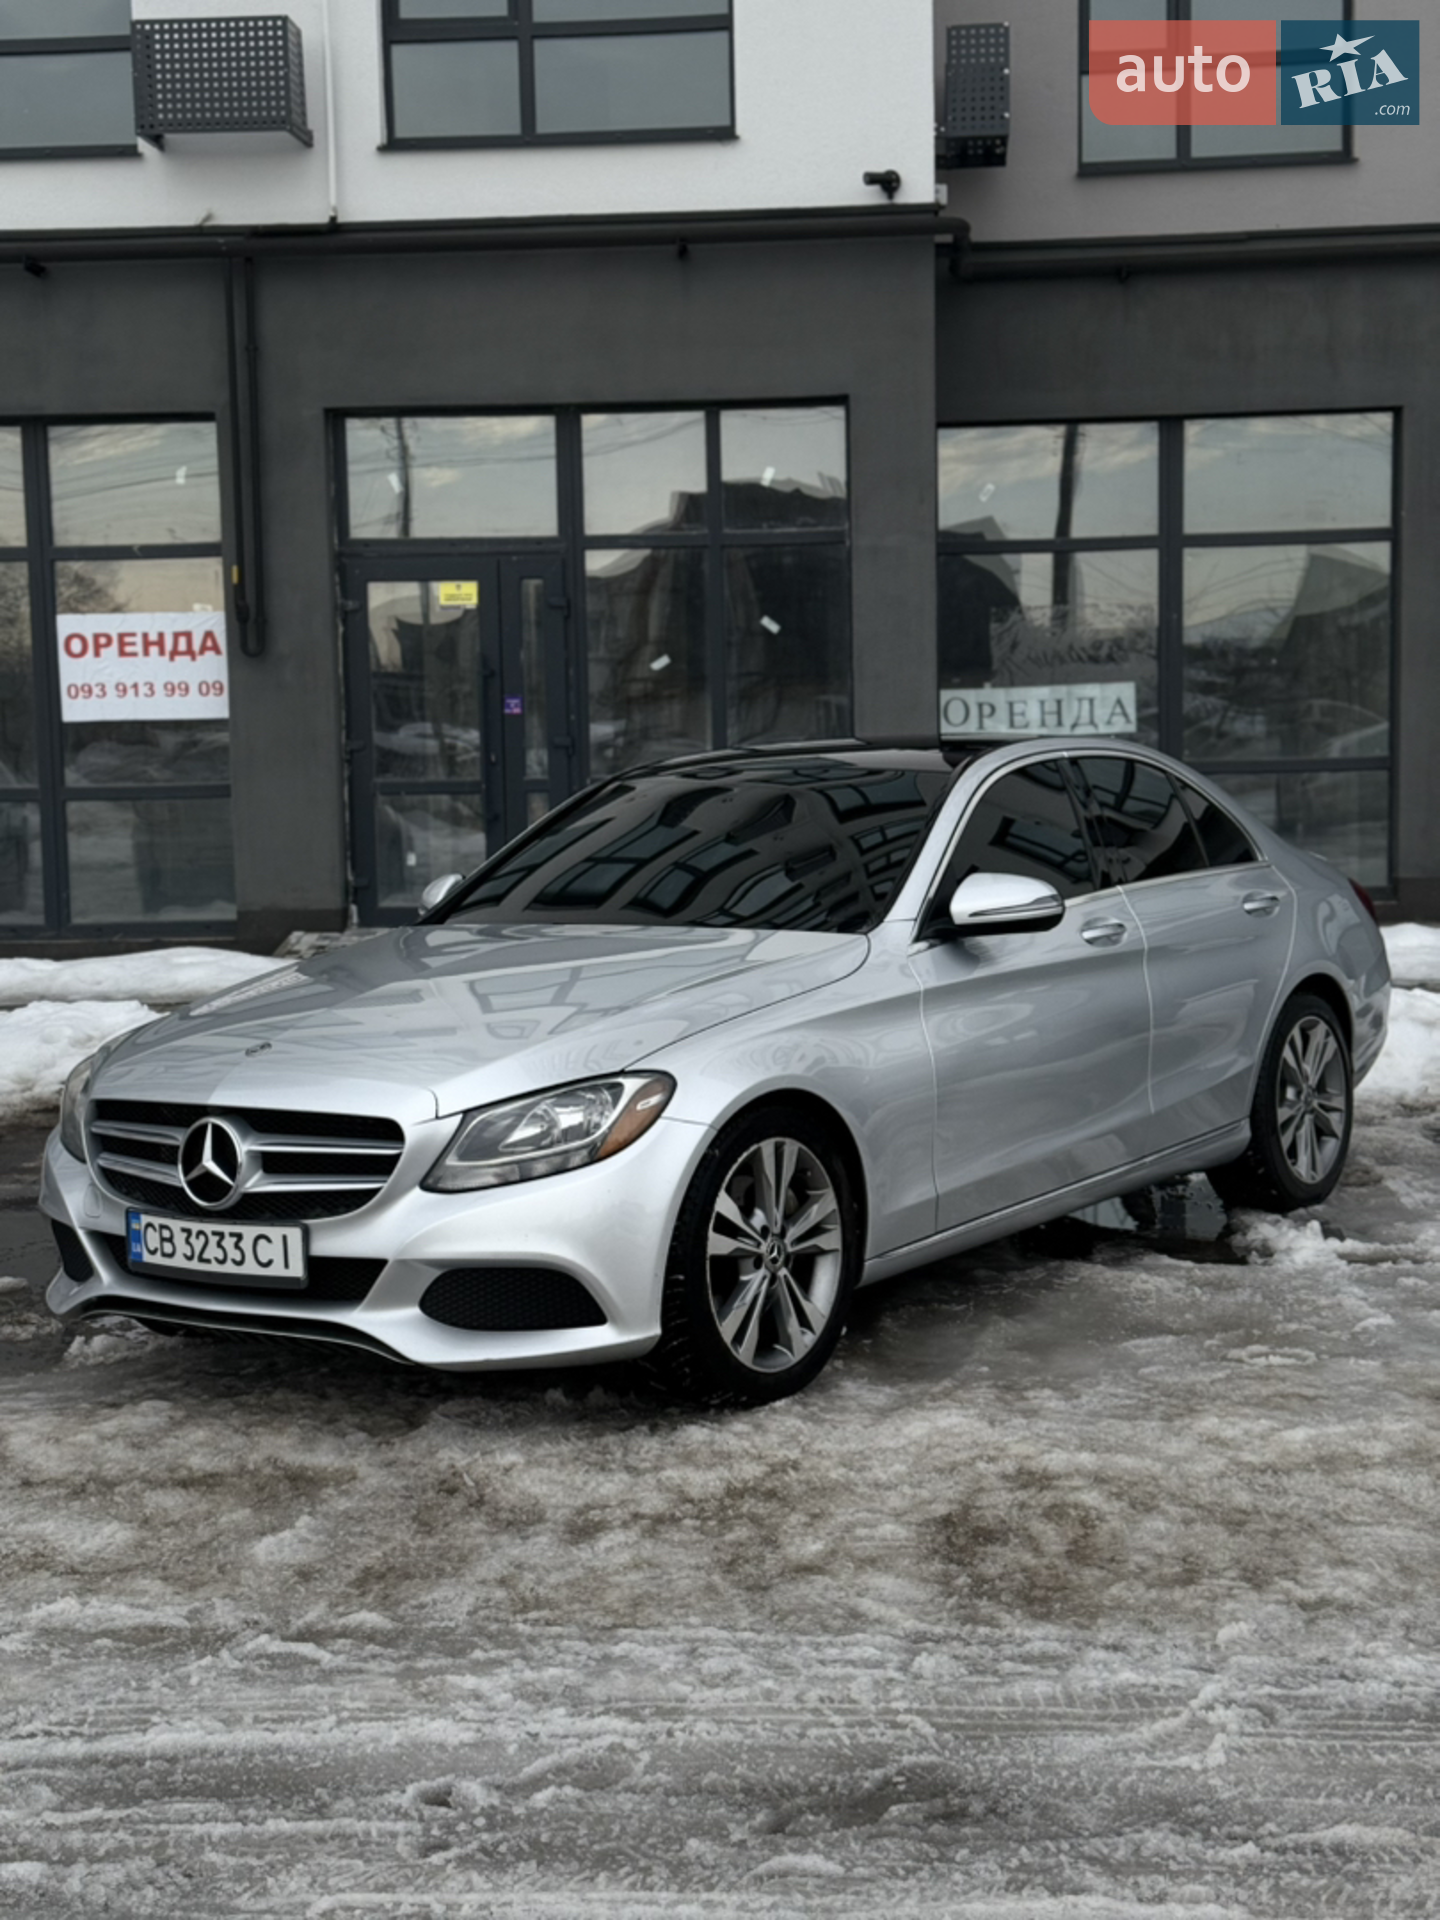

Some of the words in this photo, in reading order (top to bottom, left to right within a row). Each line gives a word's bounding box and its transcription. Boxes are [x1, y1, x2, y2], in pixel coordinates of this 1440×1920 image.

[63, 630, 223, 662] ОРЕНДА
[67, 683, 107, 700] 093
[115, 681, 156, 698] 913
[163, 680, 190, 697] 99
[198, 680, 225, 697] 09
[942, 696, 1133, 732] ОРЕНДА
[143, 1221, 177, 1259] CB
[180, 1227, 246, 1267] 3233
